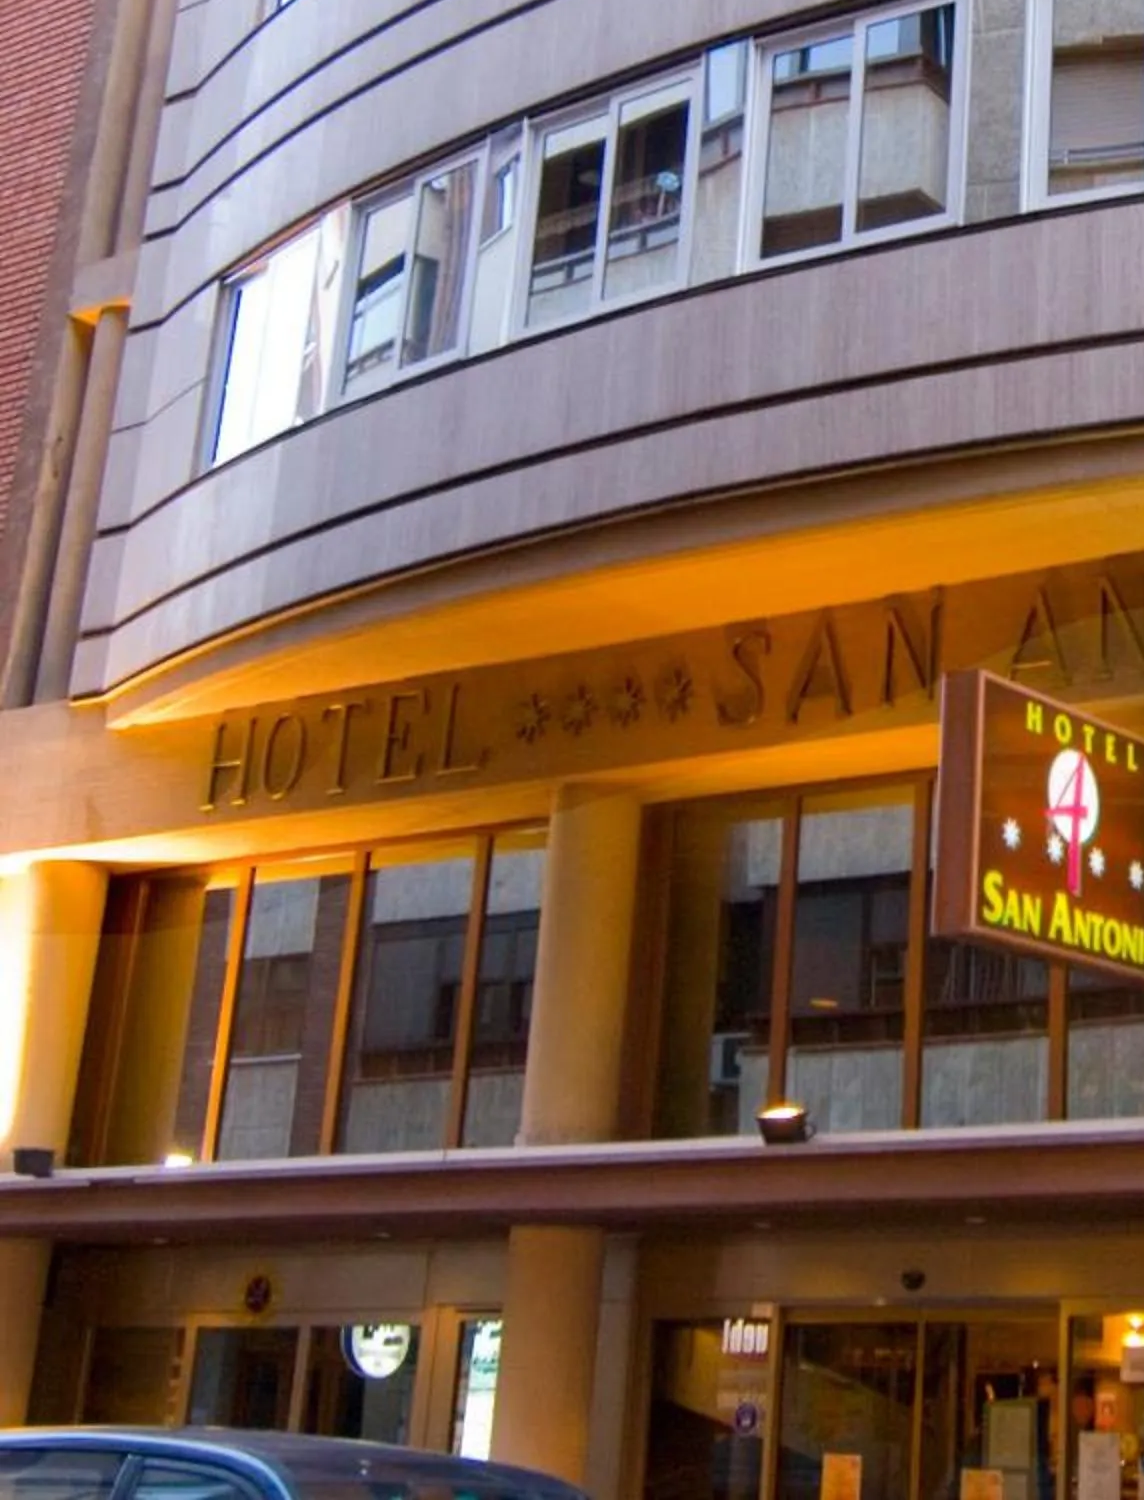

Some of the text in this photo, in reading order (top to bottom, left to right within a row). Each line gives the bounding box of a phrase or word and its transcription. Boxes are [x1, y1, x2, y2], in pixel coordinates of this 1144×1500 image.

[199, 682, 491, 812] HOTEL
[715, 584, 945, 726] SAN
[1026, 701, 1139, 772] HOTEL
[982, 870, 1042, 936] SAN
